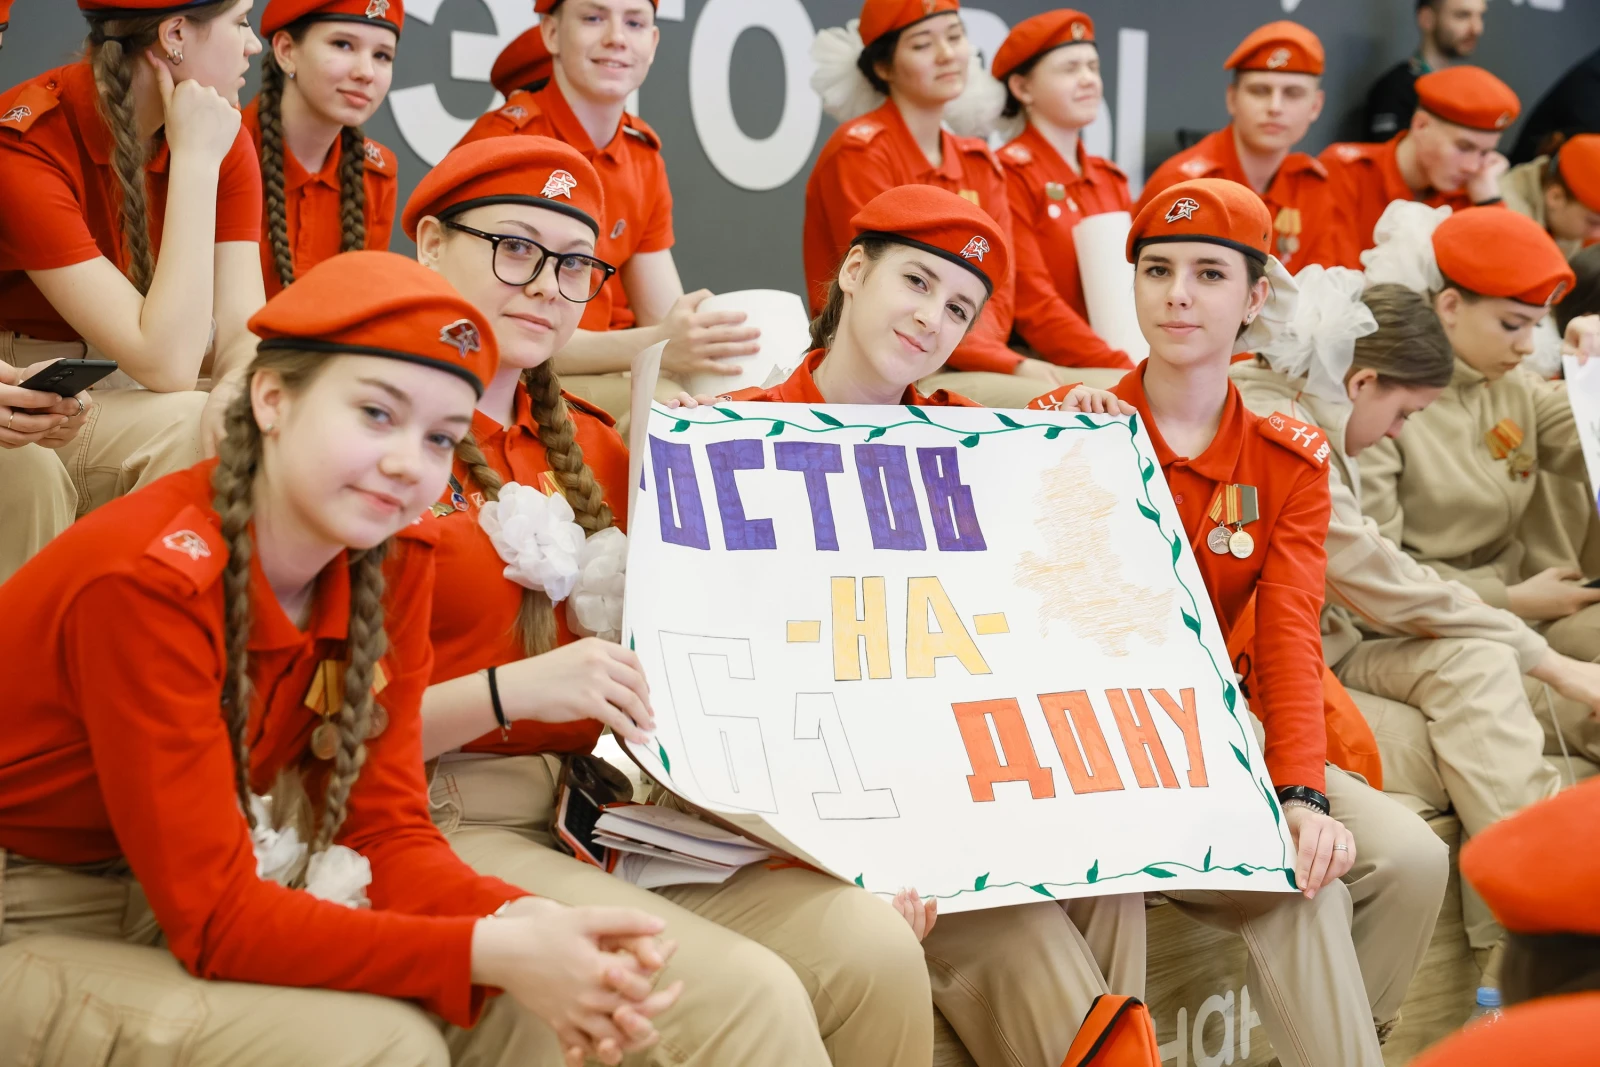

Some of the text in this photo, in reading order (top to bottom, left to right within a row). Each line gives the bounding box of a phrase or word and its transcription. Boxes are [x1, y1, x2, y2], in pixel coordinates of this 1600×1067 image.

[639, 433, 988, 551] ОСТОВ
[658, 630, 901, 820] 61
[951, 687, 1209, 802] ДОНУ
